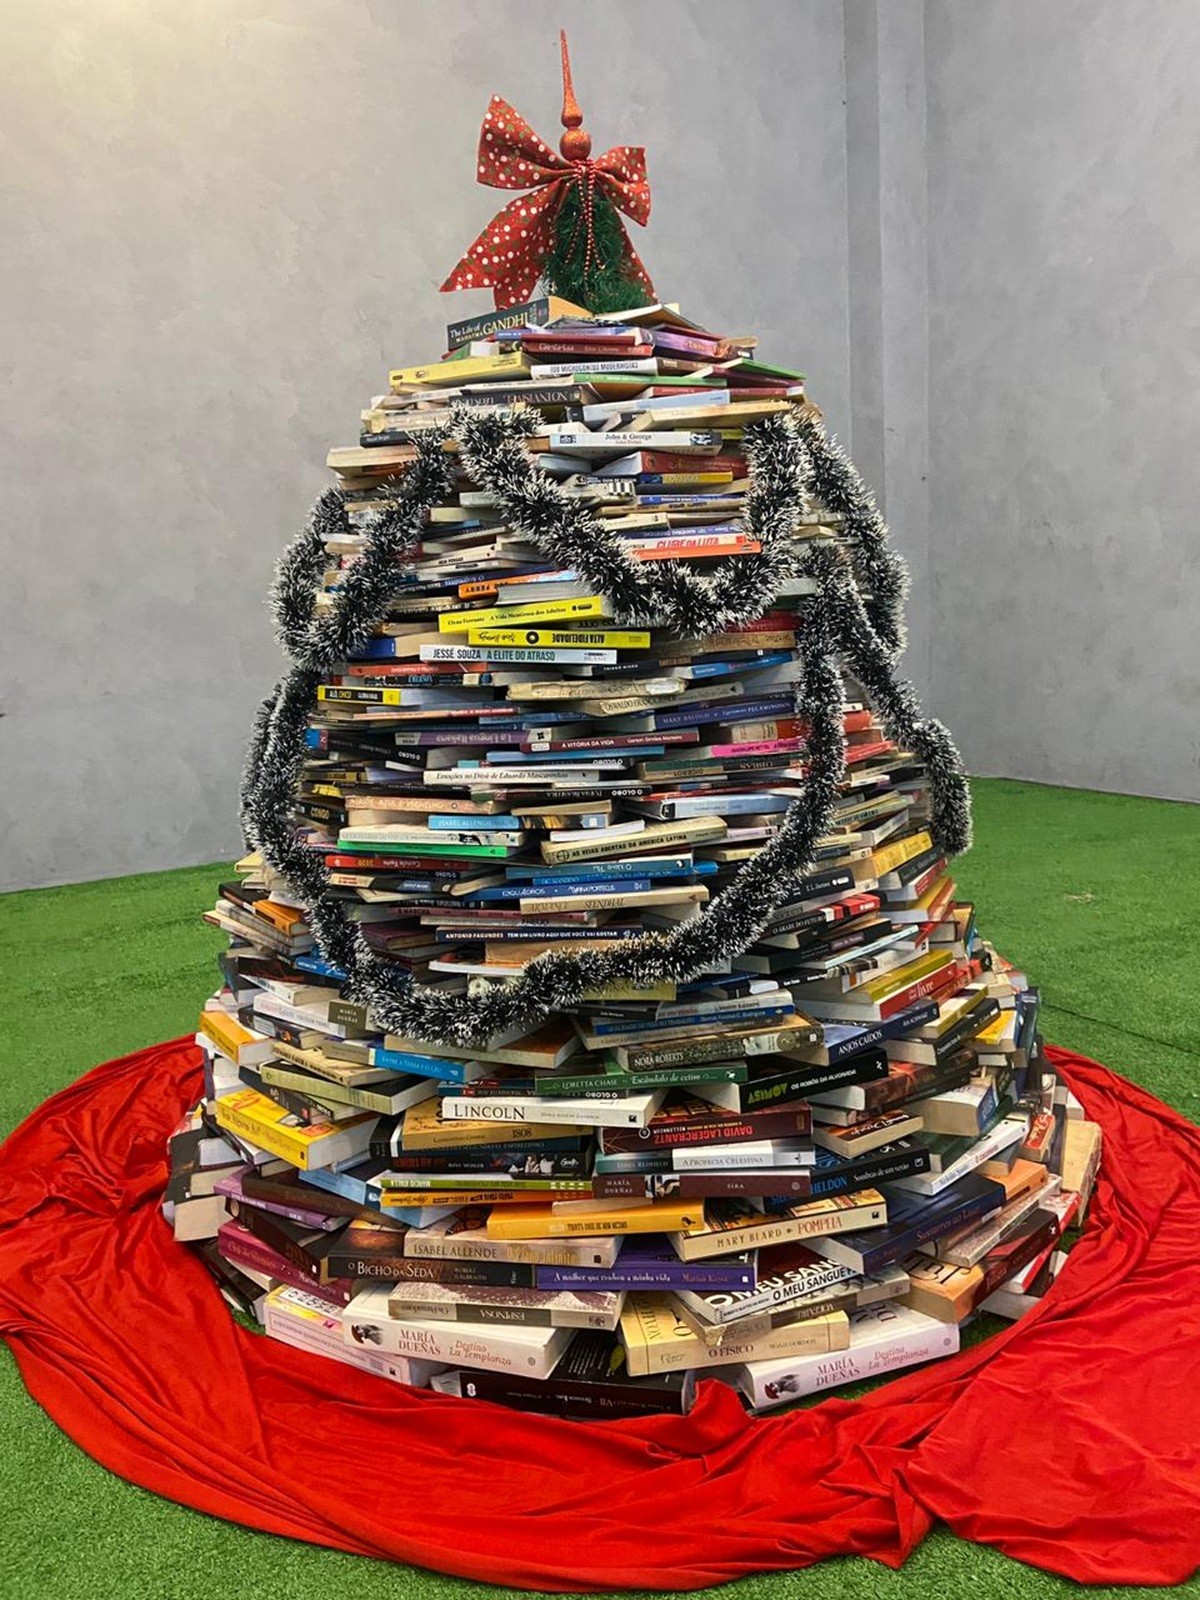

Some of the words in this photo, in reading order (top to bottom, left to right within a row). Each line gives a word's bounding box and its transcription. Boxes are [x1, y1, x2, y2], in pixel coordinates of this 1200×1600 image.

[449, 328, 461, 339] The
[461, 324, 474, 335] Life
[474, 322, 481, 332] of
[482, 312, 530, 335] GANDHI
[605, 433, 620, 441] John
[622, 433, 628, 441] &
[629, 433, 652, 442] George
[447, 617, 462, 626] Elena
[463, 615, 485, 624] Ferrante
[552, 633, 589, 644] FIDELIDADE
[590, 633, 604, 644] ALTA
[433, 648, 455, 659] JESSÉ
[457, 649, 481, 660] SOUZA
[486, 650, 492, 660] A
[492, 650, 514, 660] ELITE
[515, 650, 526, 660] DO
[527, 650, 555, 661] ATRASO
[567, 740, 590, 748] VITÓRIA
[582, 848, 599, 856] VEIAS
[601, 844, 627, 853] ABERTAS
[628, 841, 637, 849] DA
[666, 834, 687, 844] LATINA
[446, 931, 472, 939] ANTONIO
[473, 931, 504, 939] FAGUNDES
[560, 930, 571, 938] QUE
[572, 930, 586, 938] VOCÊ
[634, 1054, 655, 1068] NORA
[655, 1051, 684, 1065] ROBERTS
[562, 1079, 593, 1090] LORETTA
[594, 1078, 618, 1088] CHASE
[631, 1073, 670, 1085] Escândalo
[671, 1073, 679, 1082] de
[748, 1082, 788, 1103] ASIMOV
[800, 1077, 819, 1088] ROBÔS
[828, 1069, 857, 1082] ALVORADA
[454, 1104, 526, 1120] LINCOLN
[512, 1128, 532, 1139] 1808
[653, 1126, 686, 1134] MILLENNIUM
[654, 1128, 723, 1145] LAGERCRANTZ
[724, 1126, 754, 1137] DAVID
[689, 1158, 725, 1167] PROFECIA
[726, 1156, 764, 1165] CELESTINA
[604, 1186, 633, 1194] DUEÑAS
[810, 1174, 848, 1196] HELDON
[717, 1235, 745, 1249] MARY
[750, 1228, 782, 1243] BEARD
[797, 1216, 843, 1235] POMPEIA
[414, 1245, 446, 1256] ISABEL
[451, 1245, 498, 1259] ALLENDE
[349, 1262, 355, 1270] O
[553, 1273, 561, 1282] A
[562, 1272, 586, 1282] mulher
[587, 1275, 598, 1283] que
[599, 1274, 625, 1282] roubou
[632, 1273, 654, 1283] minha
[656, 1273, 671, 1283] vida
[773, 1291, 782, 1301] O
[783, 1283, 806, 1299] MEU
[807, 1269, 844, 1290] SANGUE
[705, 1294, 733, 1308] O
[480, 1309, 525, 1321] ESPINOSA
[399, 1329, 436, 1344] MARÍA
[399, 1338, 442, 1356] DUEÑAS
[455, 1339, 487, 1353] Destino
[709, 1349, 717, 1359] O
[718, 1344, 755, 1358] FÍSICO
[873, 1345, 906, 1360] Destino
[450, 1346, 462, 1357] La
[463, 1348, 512, 1366] Templanza
[868, 1358, 880, 1370] La
[881, 1347, 929, 1367] Templanza
[817, 1356, 855, 1376] MARÍA
[815, 1365, 861, 1387] DUEÑAS
